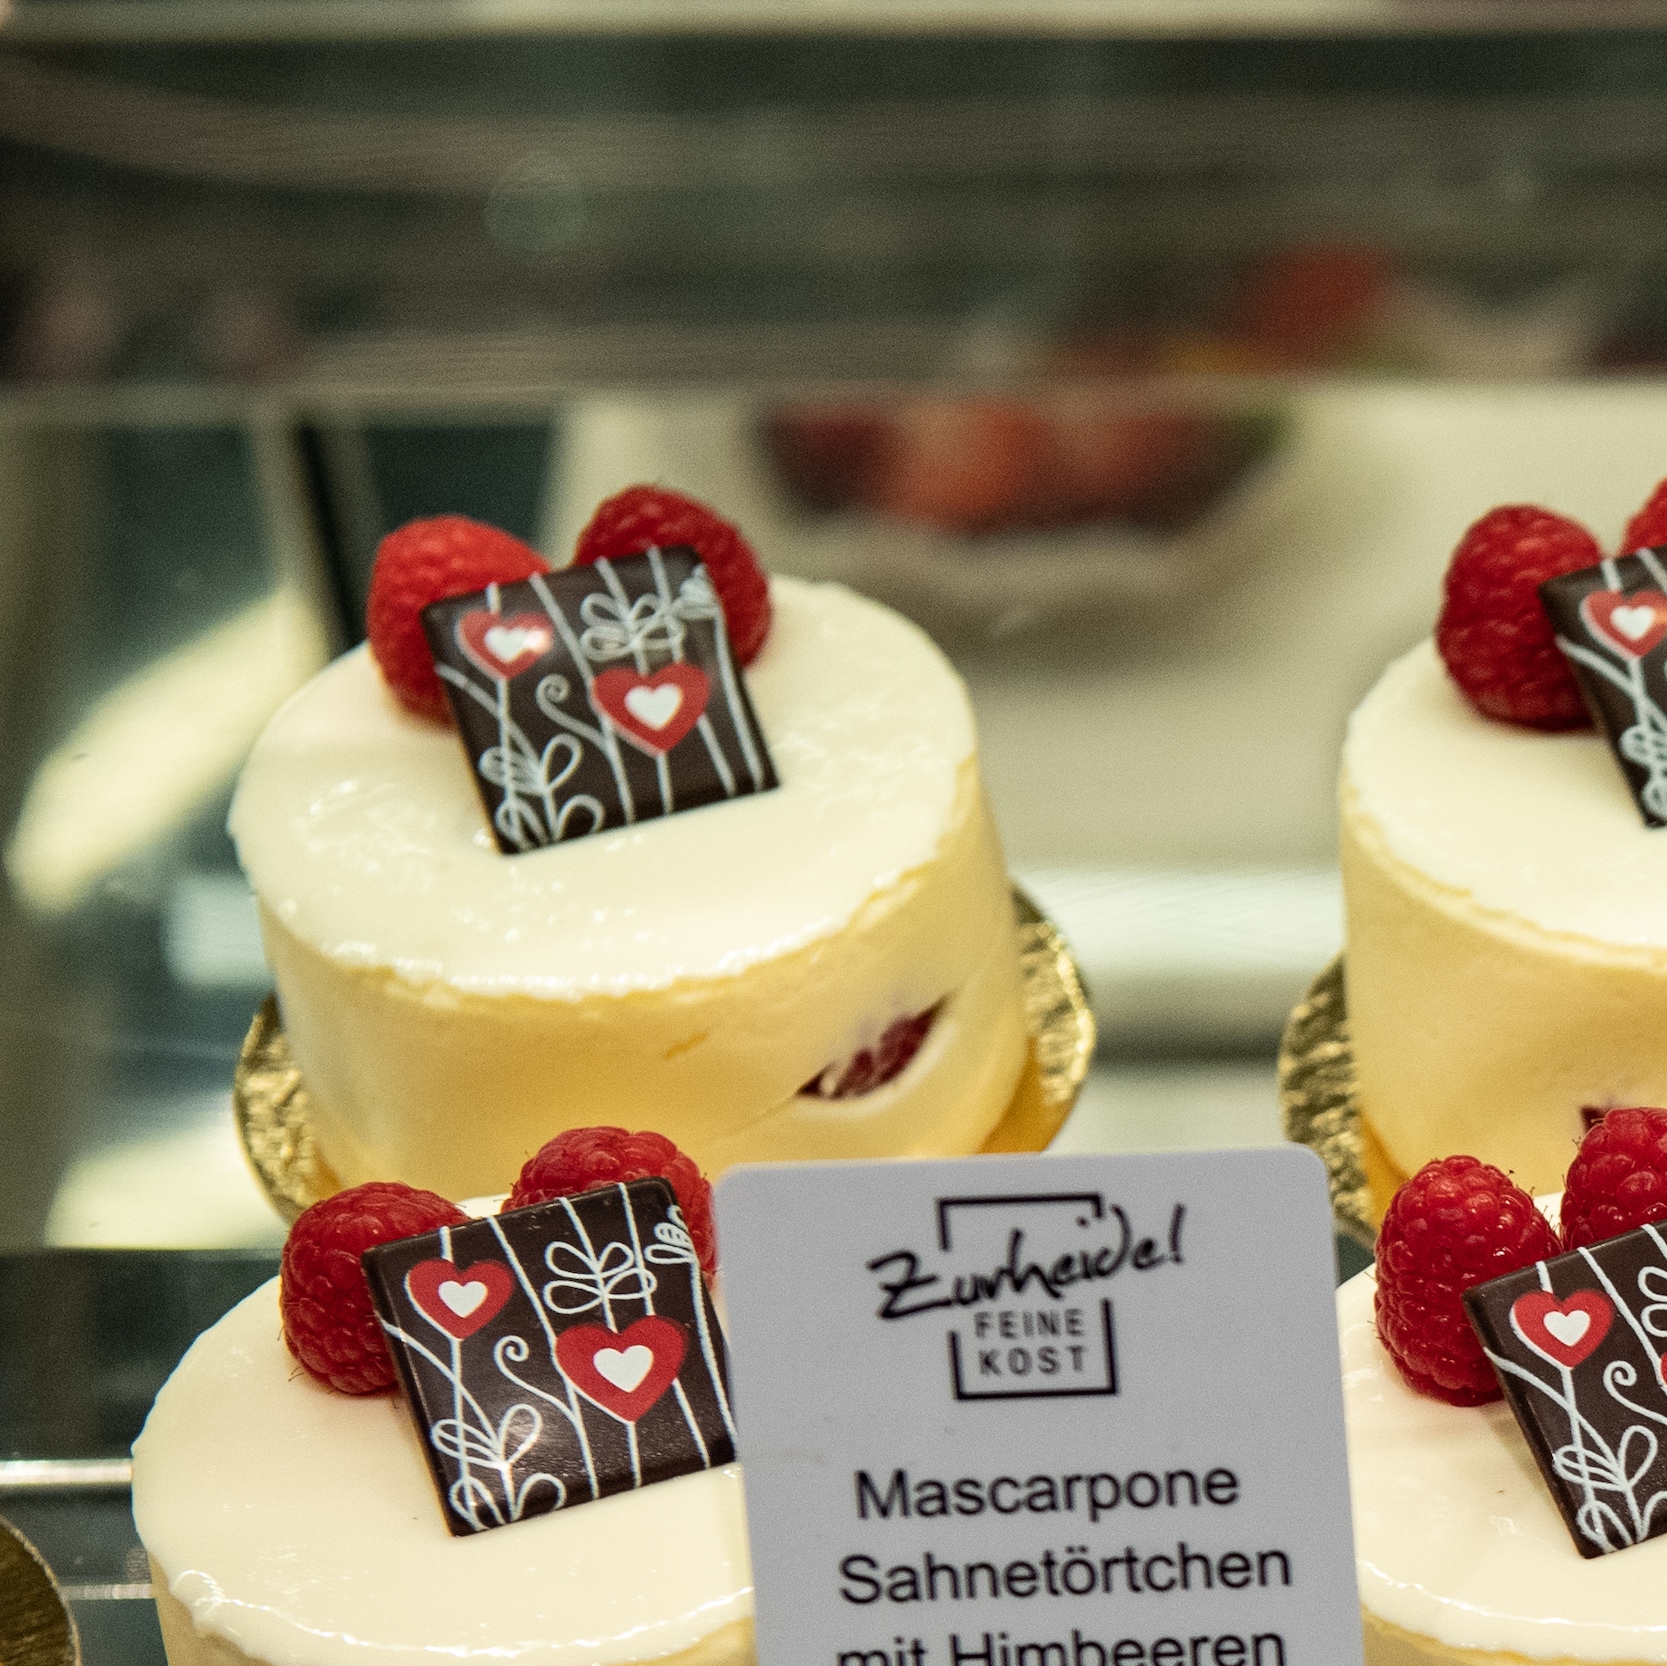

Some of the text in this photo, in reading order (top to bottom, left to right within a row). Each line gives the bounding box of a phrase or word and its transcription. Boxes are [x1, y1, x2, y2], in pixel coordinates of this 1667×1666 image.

[974, 1308, 1082, 1340] FEINE
[978, 1344, 1085, 1377] KOST
[854, 1467, 1240, 1523] Mascarpone
[839, 1541, 1292, 1606] Sahnetörtchen
